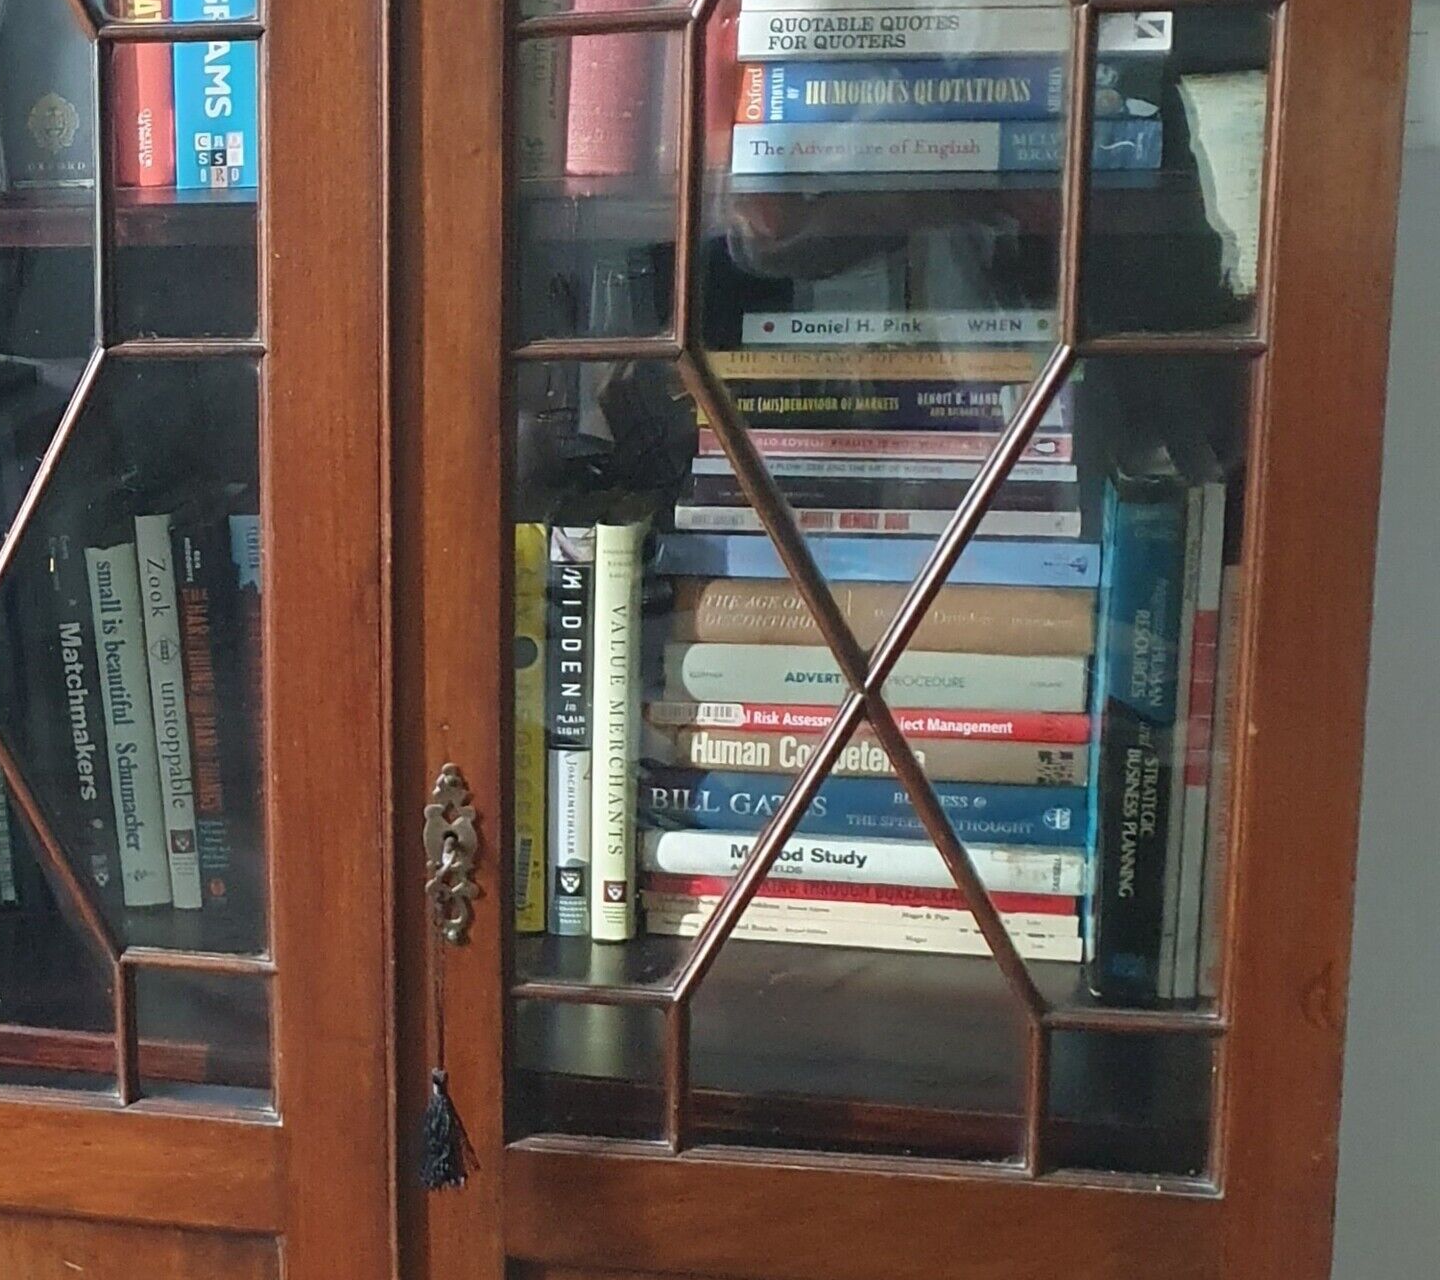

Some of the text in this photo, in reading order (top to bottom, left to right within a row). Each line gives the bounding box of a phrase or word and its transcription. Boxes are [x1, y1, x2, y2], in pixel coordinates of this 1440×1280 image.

[769, 15, 960, 34] QUOTABLE QUOTES
[768, 34, 906, 51] FOR QUOTERS
[746, 67, 762, 120] Oxford
[805, 77, 1031, 105] HUMOROUS QUOTATIONS
[749, 140, 785, 156] The
[888, 140, 908, 156] of
[913, 139, 981, 160] English
[791, 318, 922, 334] Daniel H. Pink
[967, 318, 1023, 333] WHEN
[737, 397, 754, 411] THE
[855, 396, 900, 411] MARKETS
[561, 568, 582, 697] HIDDEN
[146, 558, 194, 809] Zook unstoppable
[784, 671, 842, 684] ADVERT
[59, 622, 97, 801] Matchmakers
[96, 560, 145, 851] small is beautiful Schumacher
[753, 711, 833, 727] Risk Assessm
[899, 717, 1013, 736] ject Management
[608, 605, 628, 856] VALUE MERCHANTS
[691, 732, 926, 774] Human Copetene
[649, 787, 828, 818] BILL GATS
[893, 792, 969, 807] BUESS
[1118, 748, 1143, 899] BUSINESS PLANNING
[810, 847, 869, 869] Study
